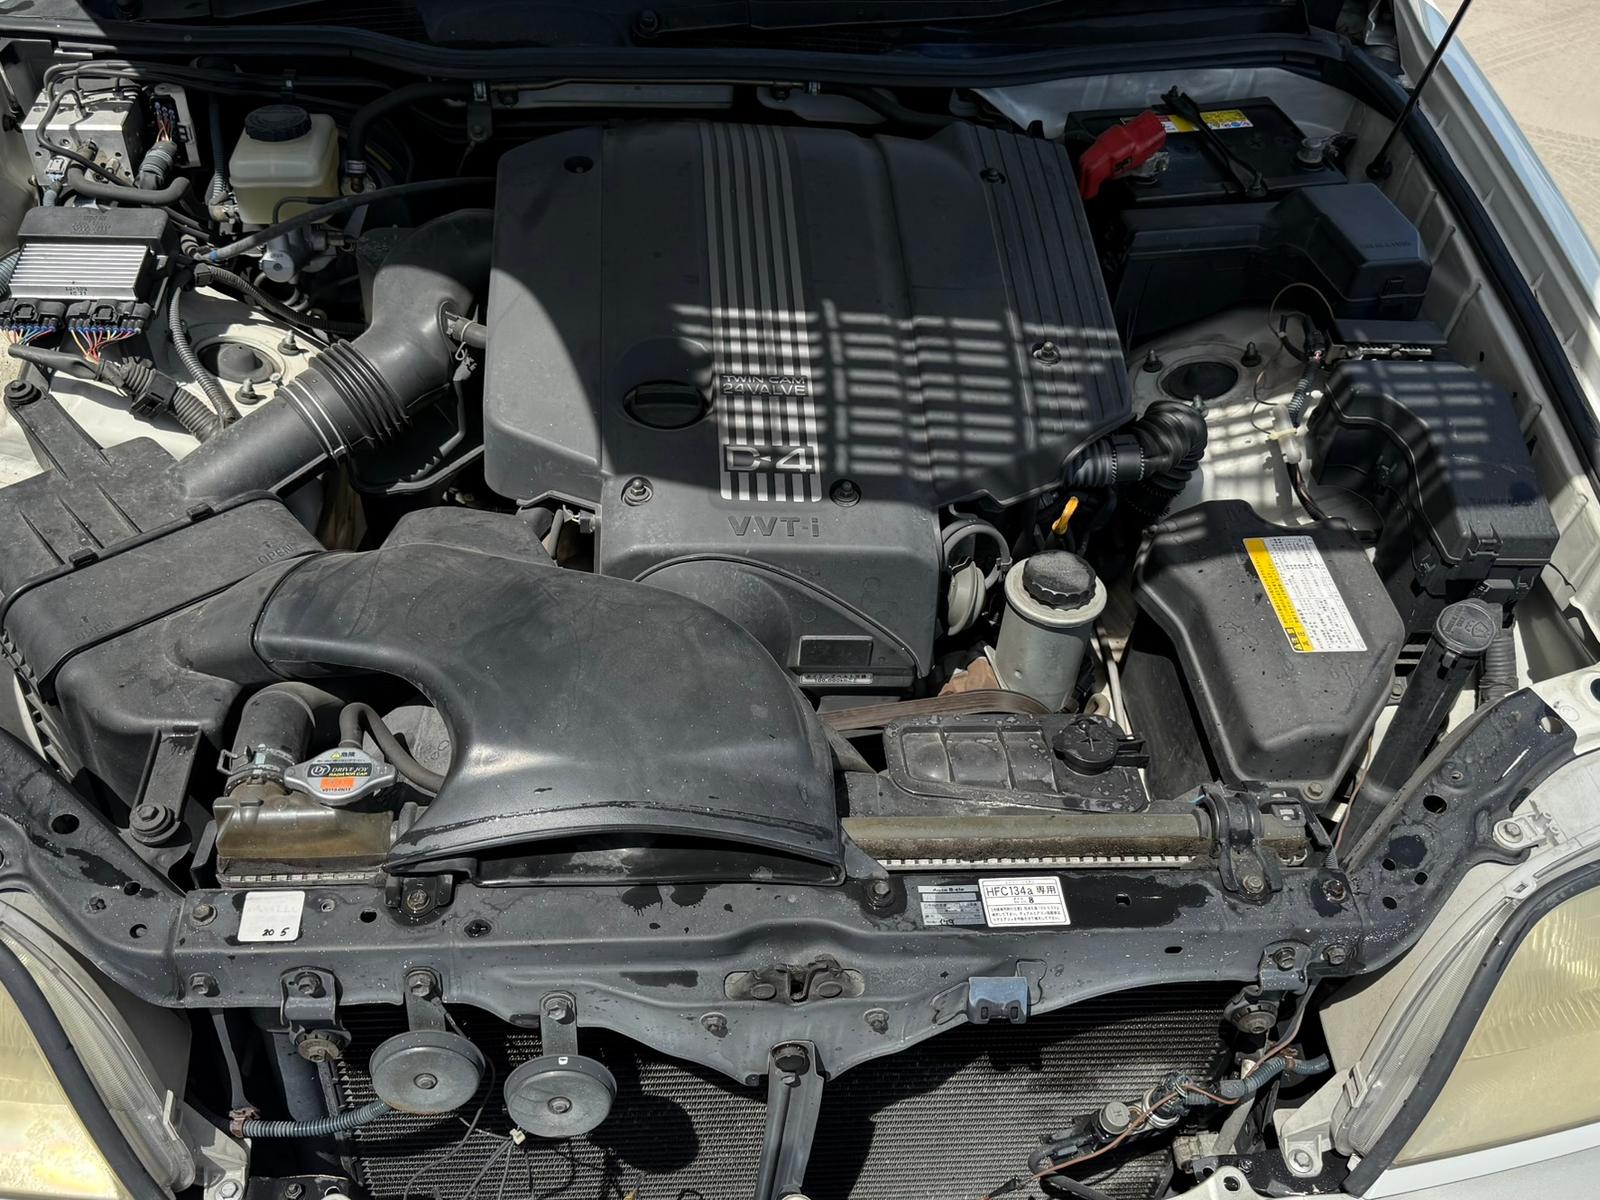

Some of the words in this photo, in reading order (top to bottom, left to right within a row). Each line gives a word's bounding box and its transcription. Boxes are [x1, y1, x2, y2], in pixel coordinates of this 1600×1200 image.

[723, 375, 764, 383] TWIN
[769, 376, 805, 385] CAM
[726, 446, 813, 472] D-4
[728, 516, 820, 537] VVT-i
[257, 543, 297, 565] OPEN
[74, 619, 114, 641] OPEN
[985, 886, 1034, 897] HFC134a
[1036, 885, 1057, 895] 専用
[262, 929, 275, 937] 20
[280, 927, 290, 937] 5
